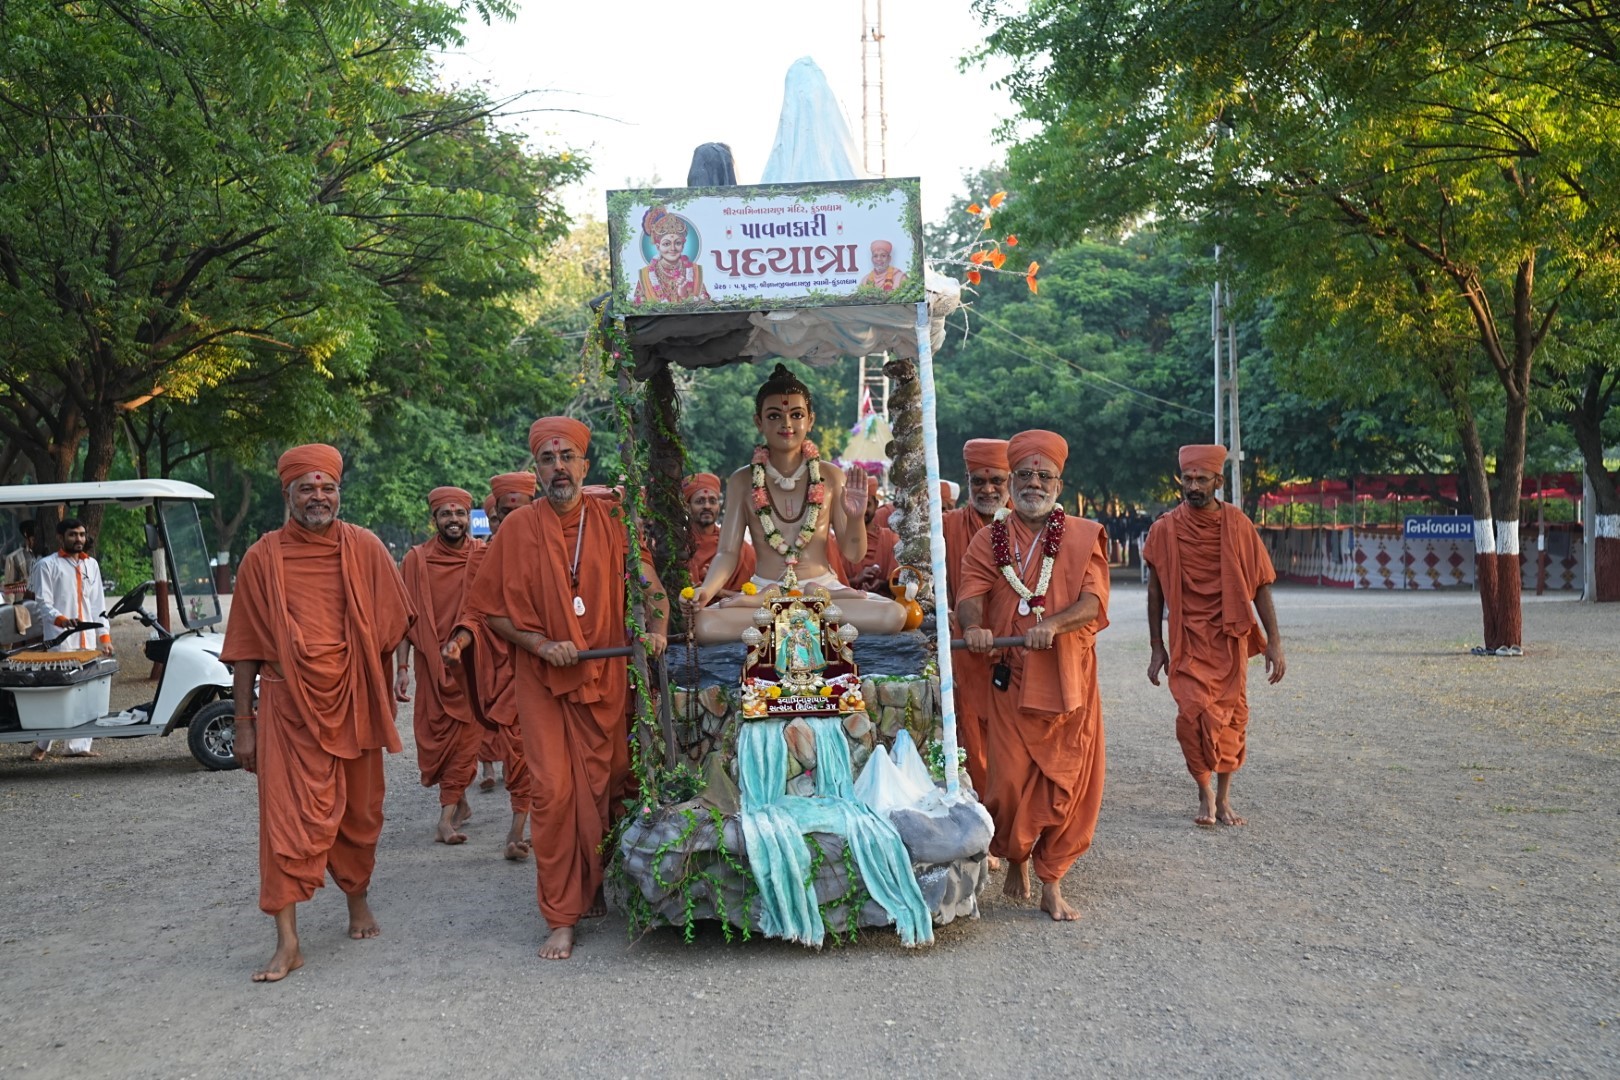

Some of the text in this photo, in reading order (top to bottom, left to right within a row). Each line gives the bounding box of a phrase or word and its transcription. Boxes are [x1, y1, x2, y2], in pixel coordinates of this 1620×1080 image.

[787, 203, 808, 214] મંદિર,
[810, 203, 842, 215] કુંડળધામ
[740, 213, 827, 239] પાવનકારી
[710, 244, 859, 277] પદયાત્રા
[1406, 518, 1471, 534] નિર્મળબાગ
